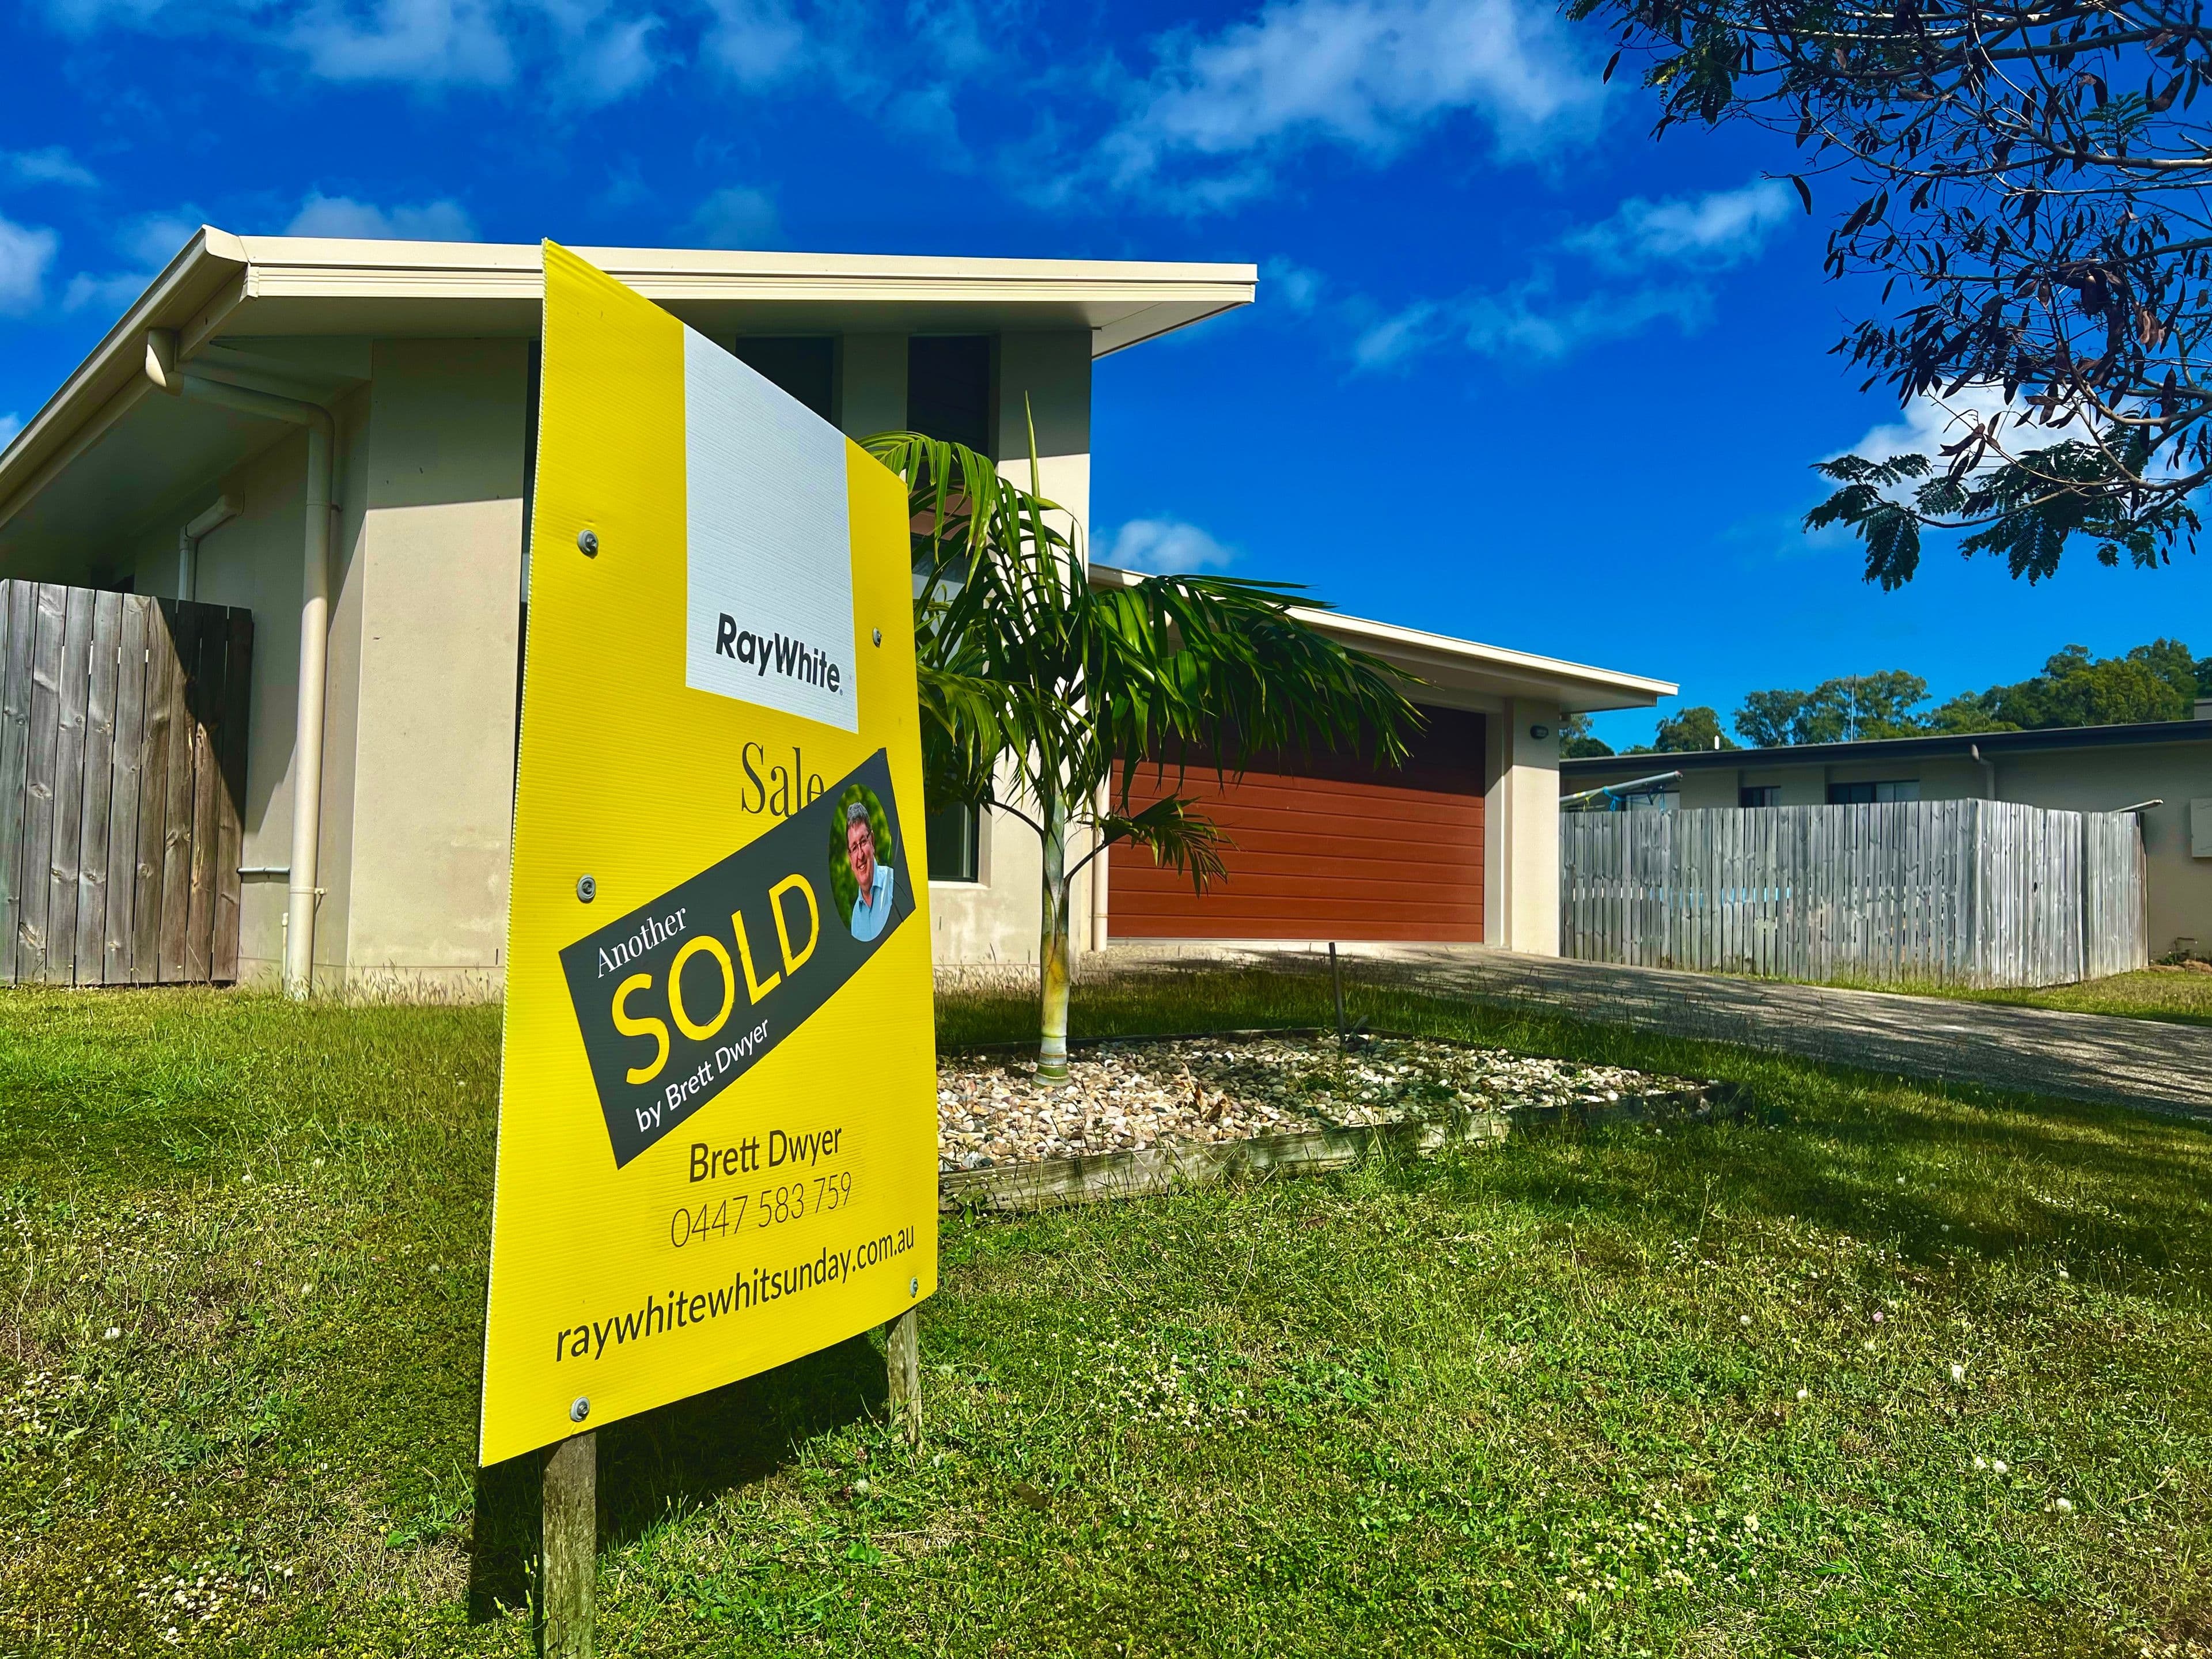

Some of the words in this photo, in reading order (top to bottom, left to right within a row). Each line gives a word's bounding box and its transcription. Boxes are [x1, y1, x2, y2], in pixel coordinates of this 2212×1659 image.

[715, 612, 840, 692] RayWhite
[741, 742, 824, 818] Sale
[597, 907, 687, 978] Another
[612, 874, 819, 1084] SOLD
[635, 1102, 661, 1132] by
[665, 1061, 714, 1111] Brett
[715, 1019, 770, 1073] Dwyer
[690, 1135, 760, 1183] Brett
[768, 1127, 842, 1167] Dwyer
[671, 1195, 749, 1248] 0447
[758, 1183, 804, 1228] 583
[813, 1171, 852, 1214] 759
[556, 1225, 915, 1362] raywhitewhitsunday.com.au
